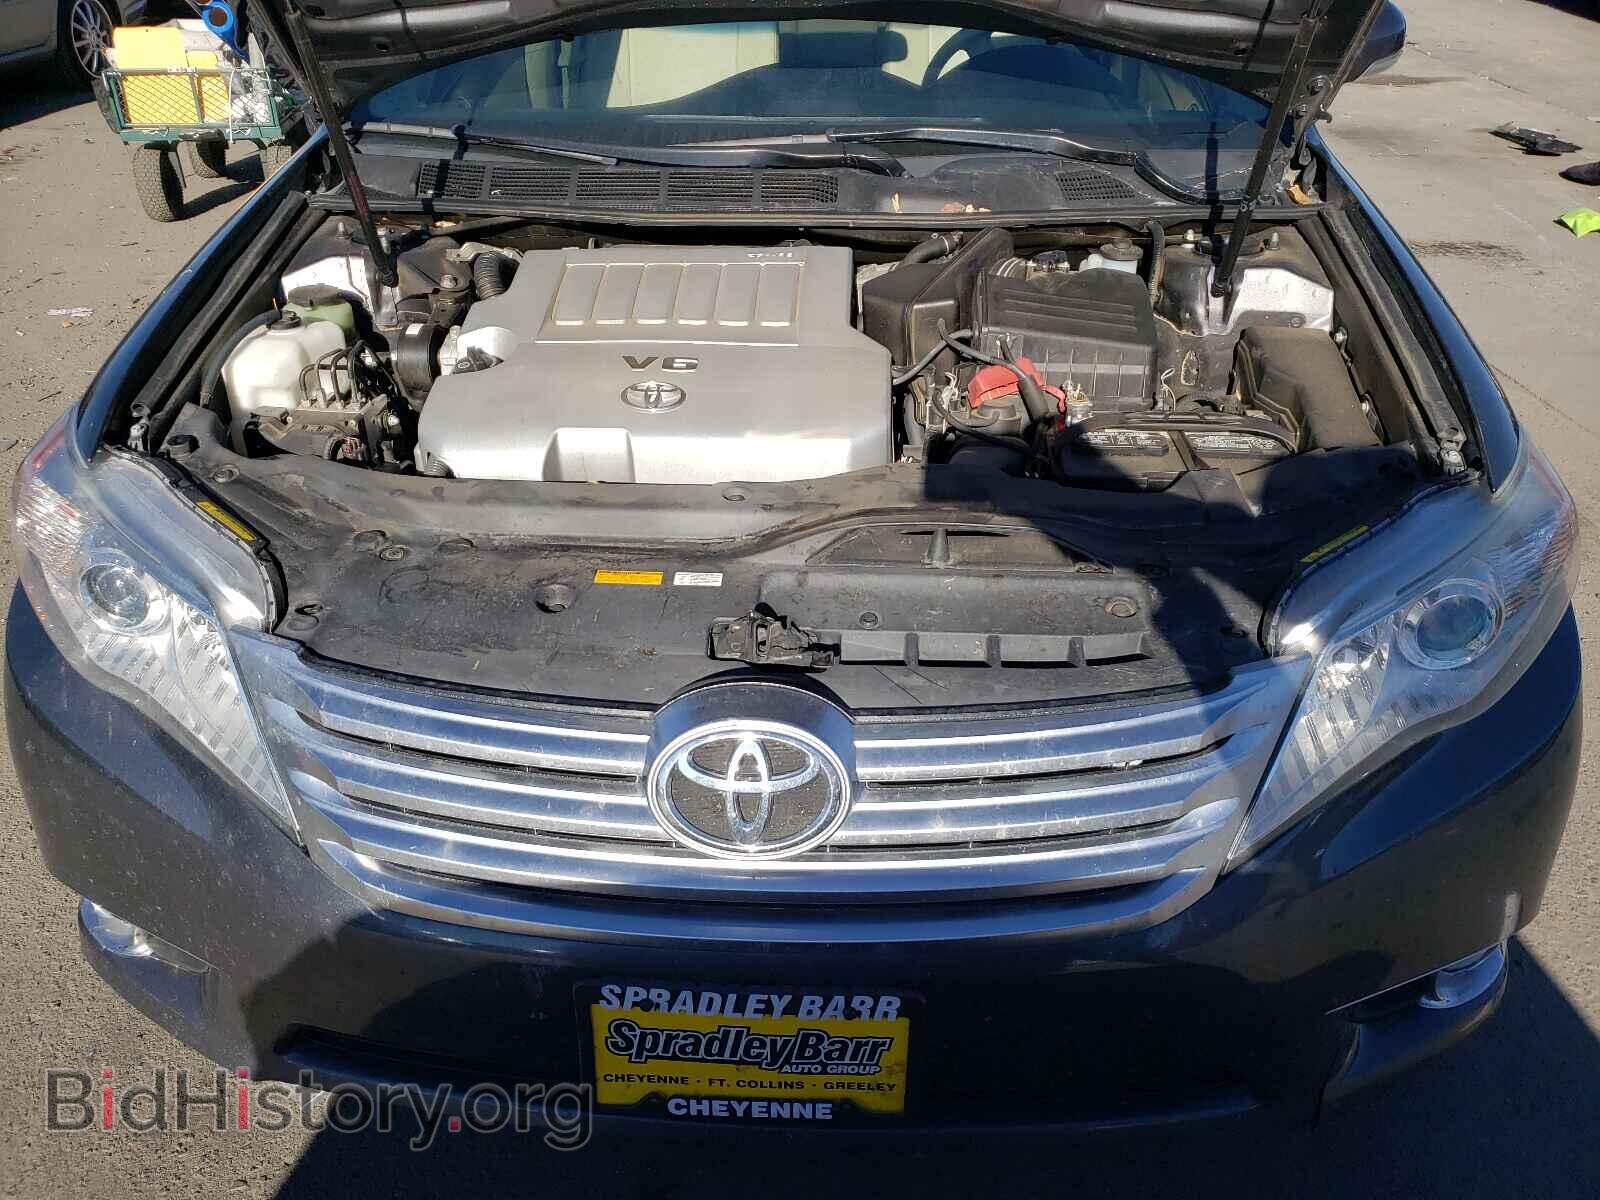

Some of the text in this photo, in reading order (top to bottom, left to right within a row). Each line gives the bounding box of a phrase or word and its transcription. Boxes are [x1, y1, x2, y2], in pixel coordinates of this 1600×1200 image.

[622, 355, 699, 372] V6
[600, 984, 901, 1022] SPRADLEY BARR
[780, 1064, 881, 1075] AUTO GROUP
[603, 1073, 897, 1091] CHEYENNE FT. COLLINS GREELEY
[667, 1098, 833, 1120] CHEYENNE
